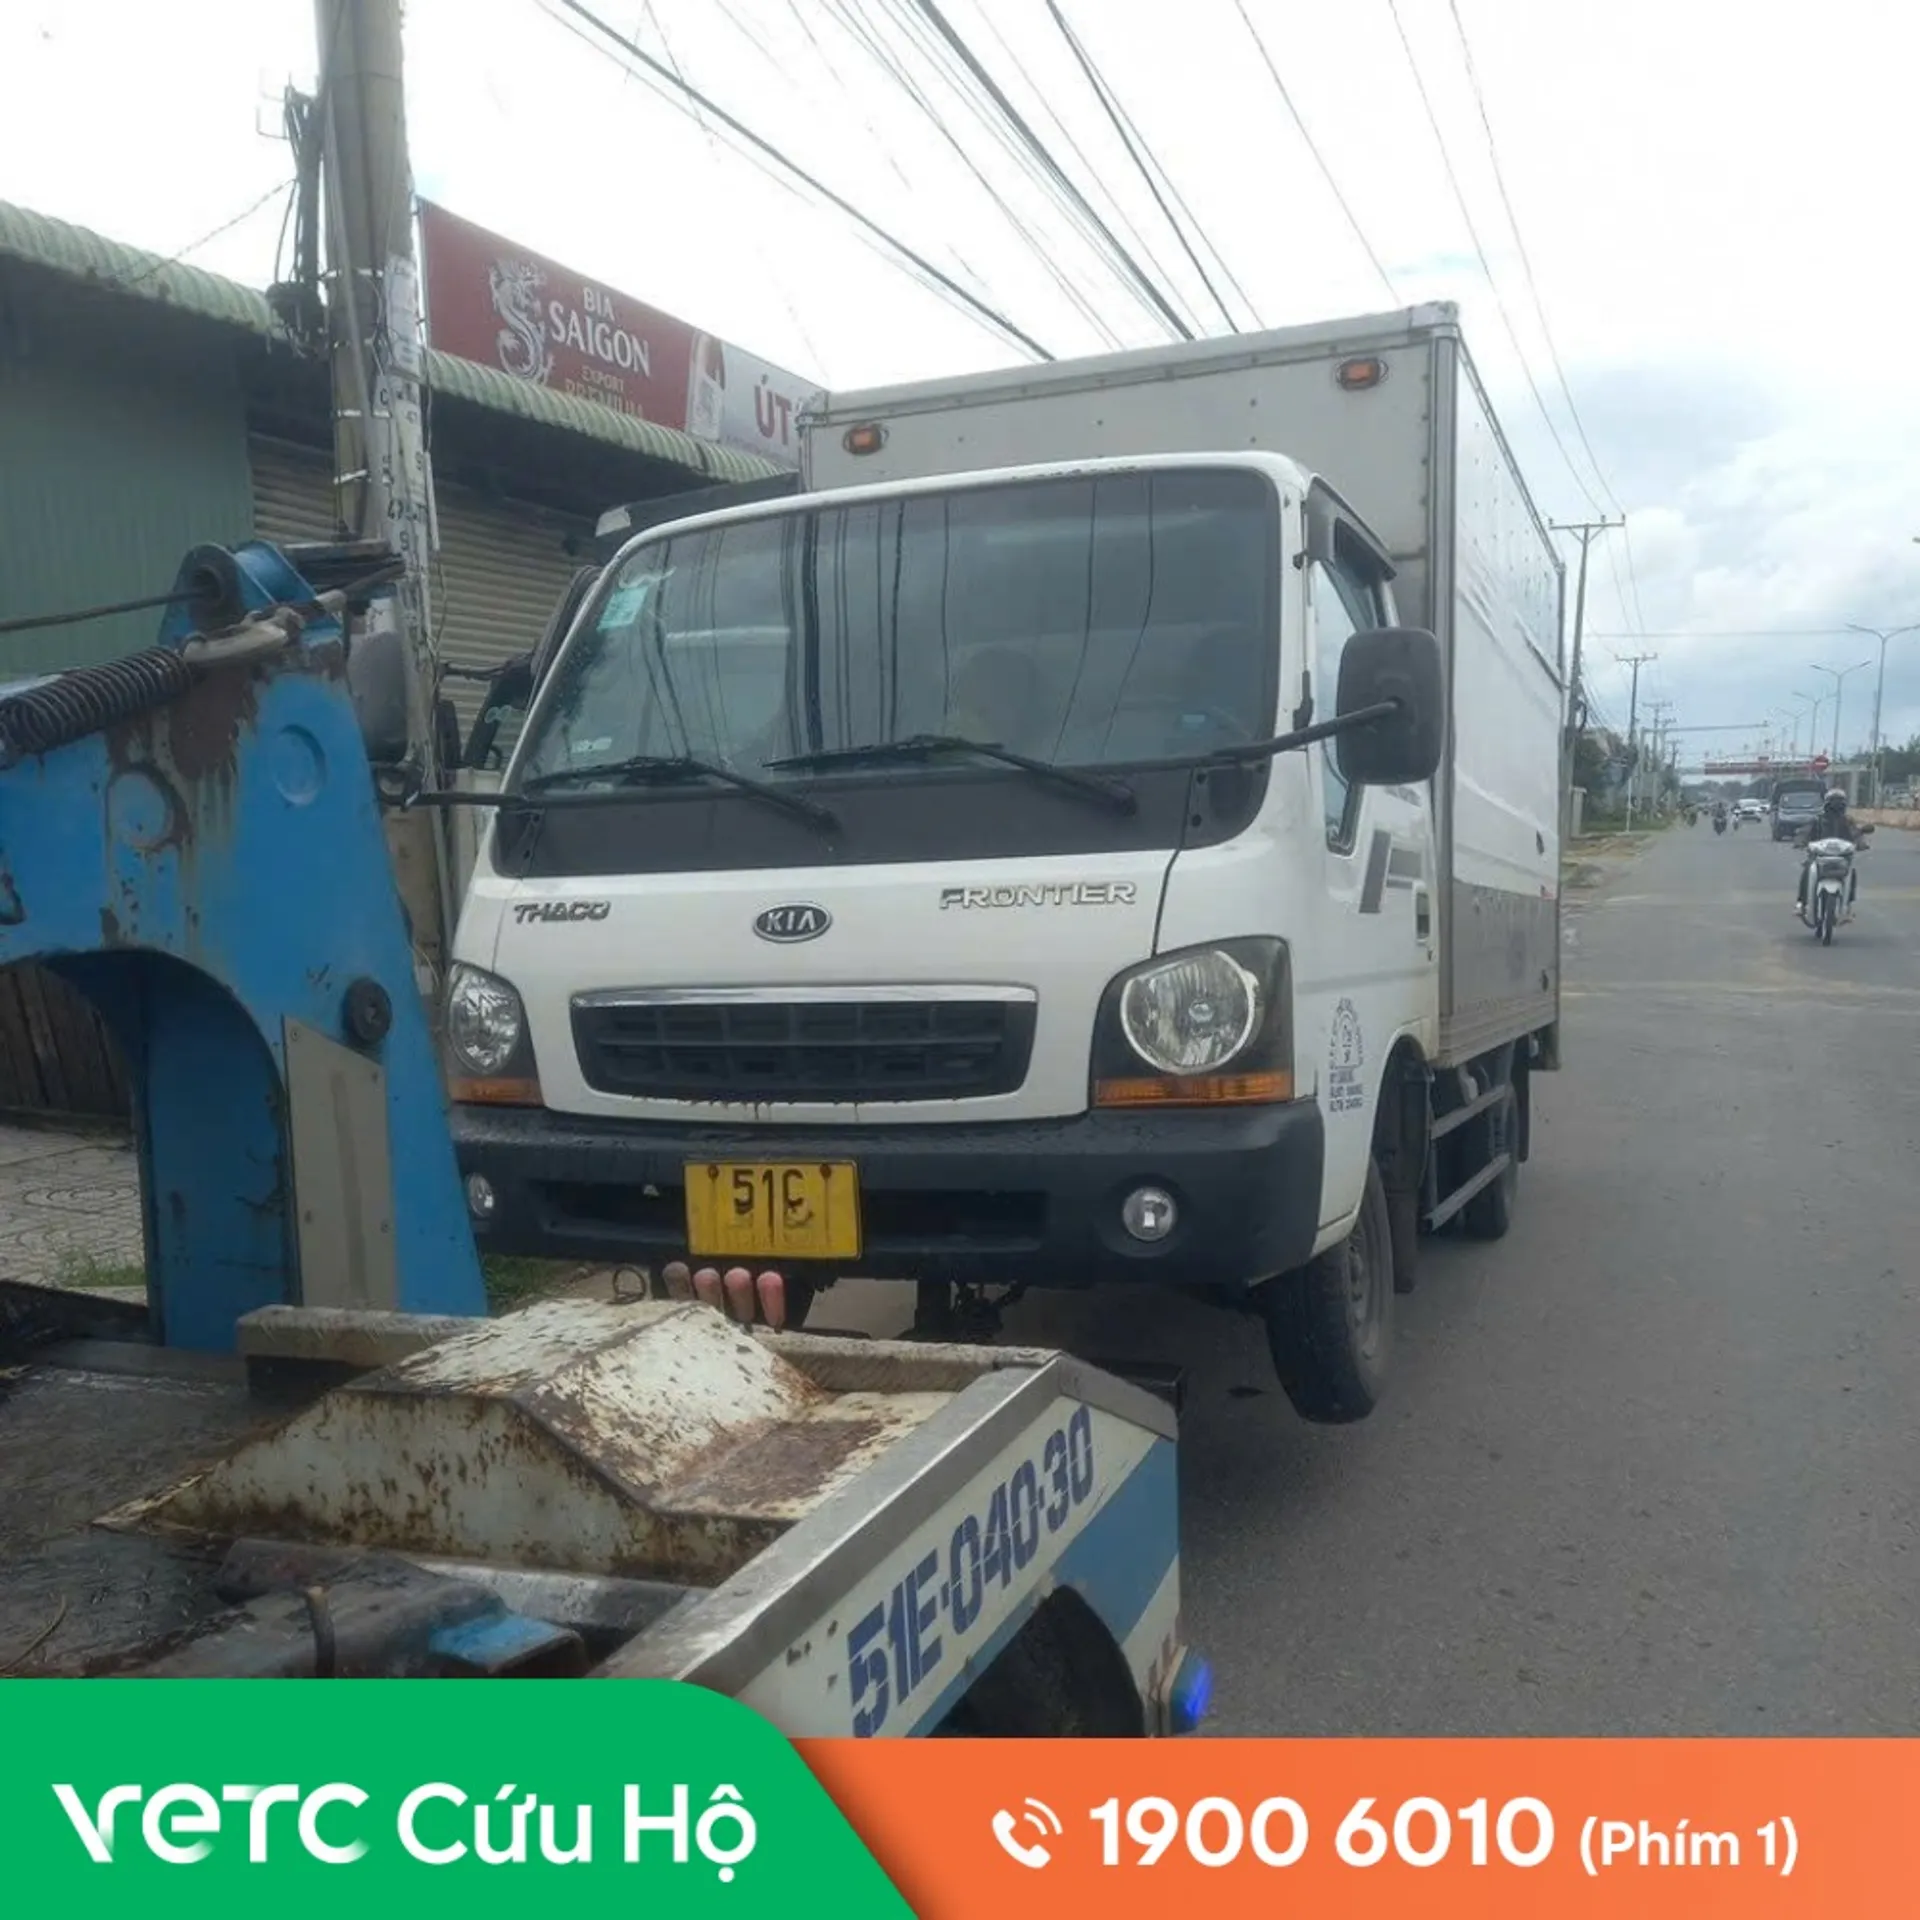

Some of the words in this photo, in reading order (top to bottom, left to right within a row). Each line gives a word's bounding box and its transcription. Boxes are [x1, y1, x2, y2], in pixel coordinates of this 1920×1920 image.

[583, 287, 615, 321] BIA
[549, 301, 650, 378] SAIGON
[939, 881, 1136, 909] FRONTIER
[513, 900, 610, 924] THACO
[765, 906, 815, 934] KIA
